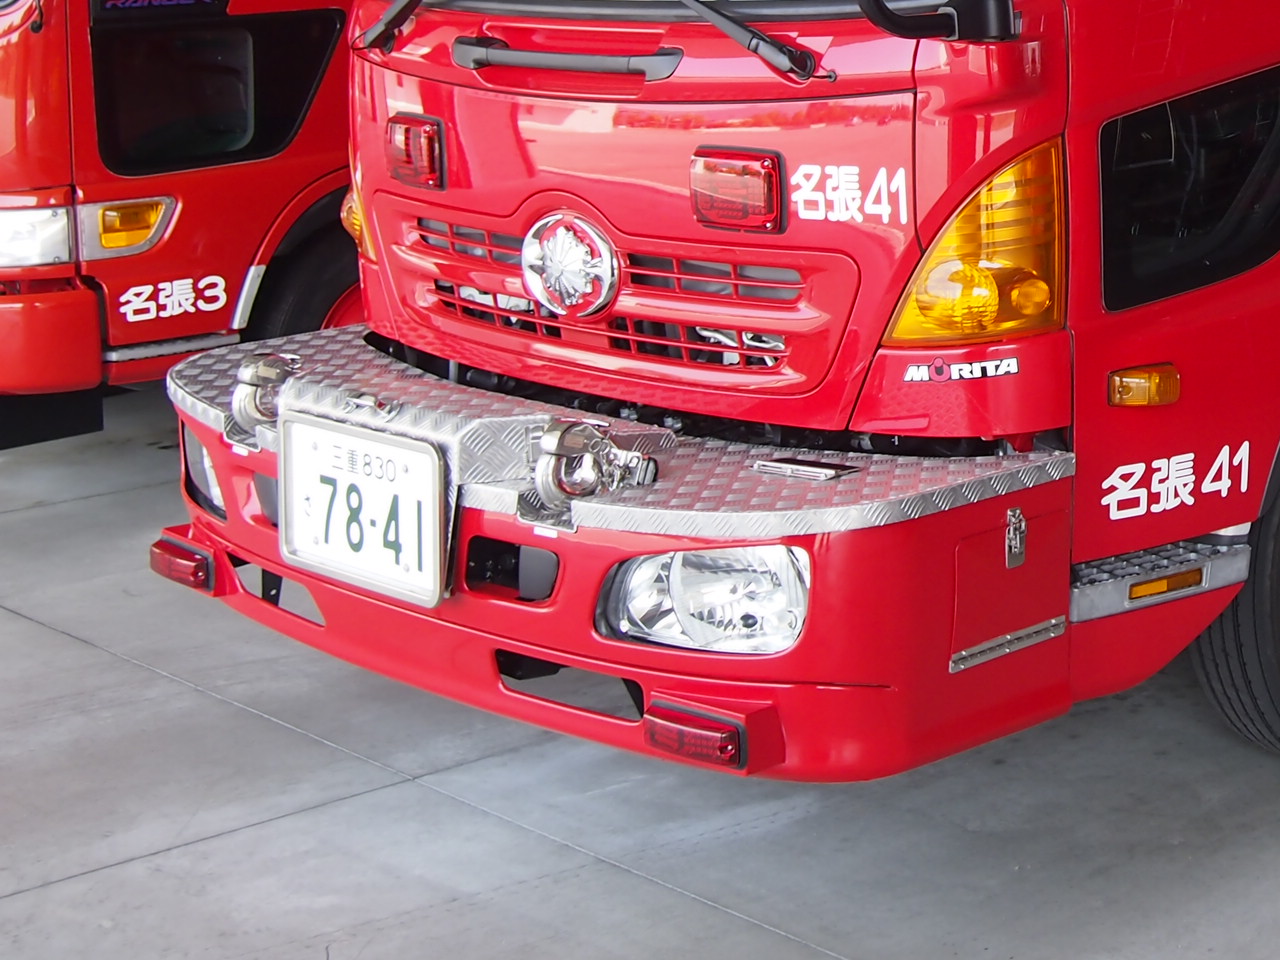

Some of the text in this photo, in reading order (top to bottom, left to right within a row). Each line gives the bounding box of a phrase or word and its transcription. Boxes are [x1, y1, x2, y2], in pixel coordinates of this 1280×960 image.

[790, 163, 909, 225] 名張41
[119, 275, 228, 323] 名張3
[903, 356, 1019, 383] MORITA
[1100, 440, 1251, 521] 名張41
[319, 473, 424, 573] 78-41
